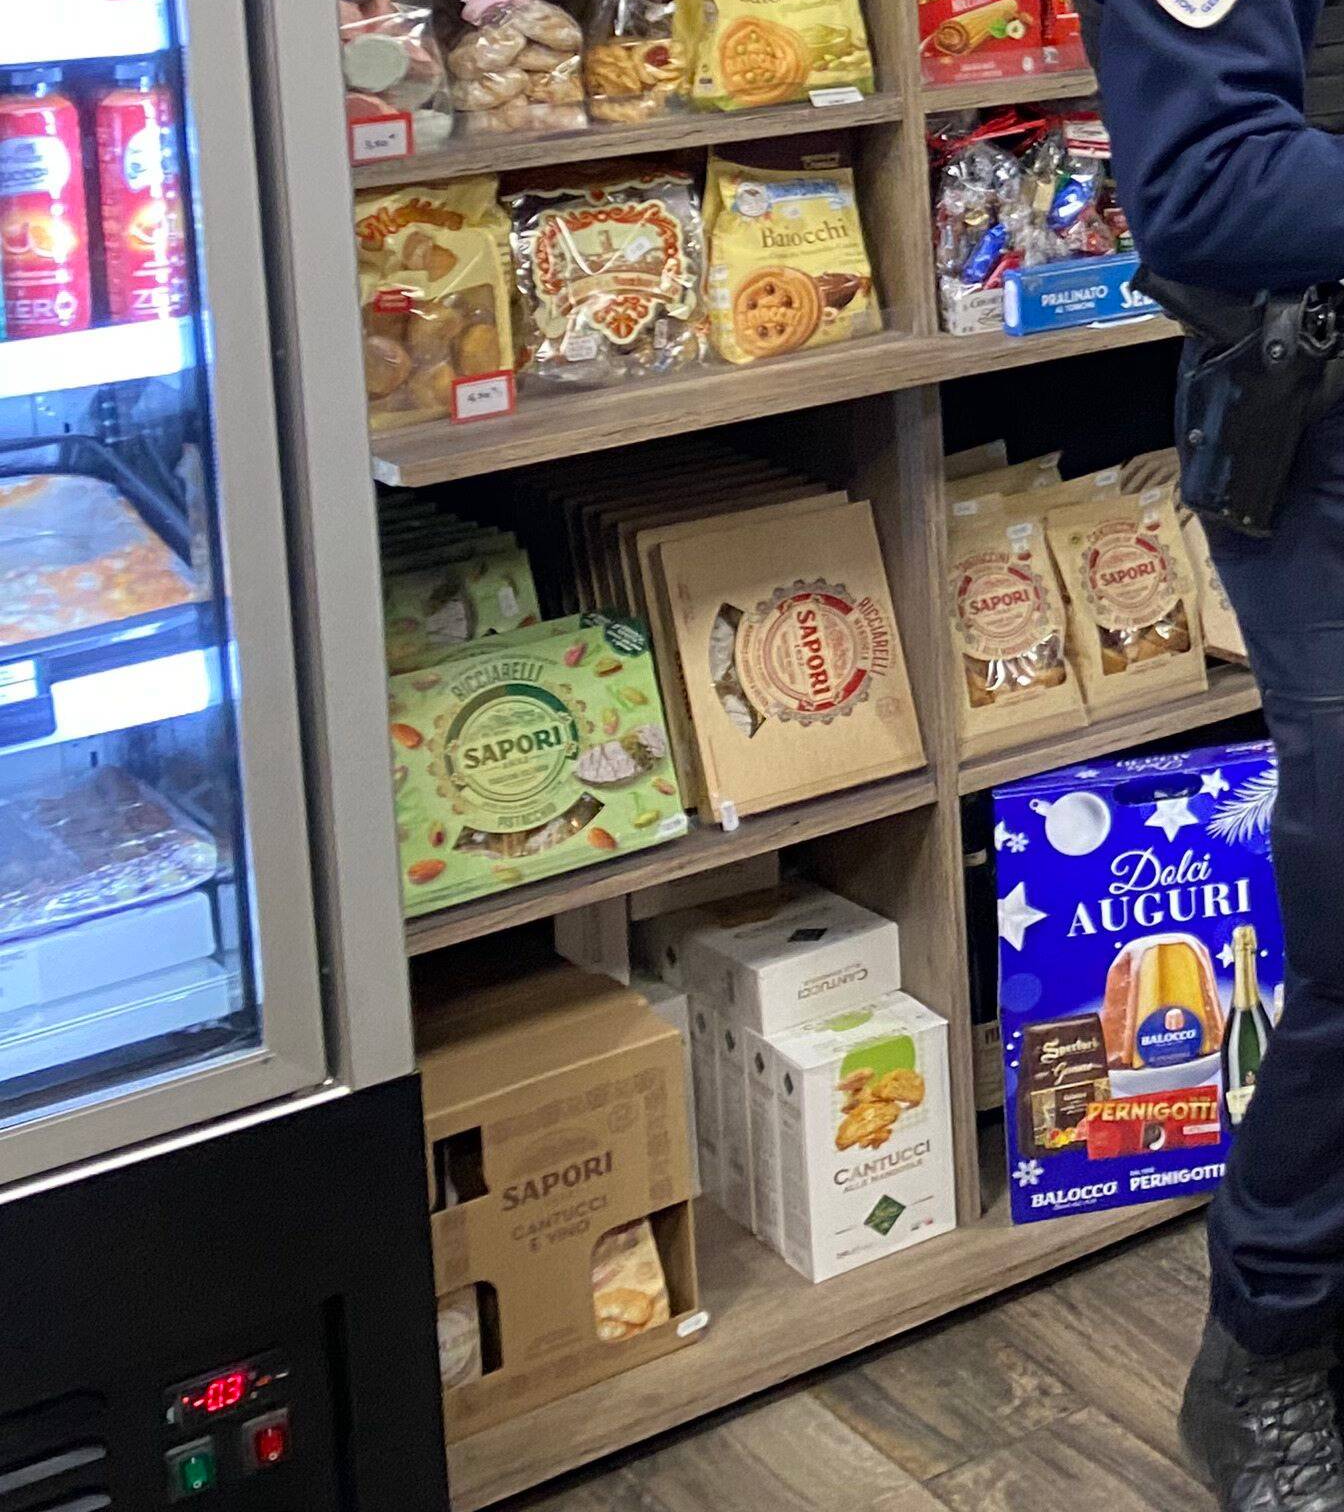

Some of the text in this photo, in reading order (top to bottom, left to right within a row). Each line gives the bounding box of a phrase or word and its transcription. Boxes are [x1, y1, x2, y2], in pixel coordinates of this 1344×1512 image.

[761, 217, 849, 249] Baiocchi
[1041, 285, 1108, 307] PRALINATO
[1101, 560, 1157, 587] SAPORI
[969, 589, 1030, 615] SAPORI
[796, 608, 831, 696] SAPORI
[857, 595, 890, 678] RICCIARELLI
[451, 661, 545, 702] RICCIARELLI
[463, 725, 563, 770] SAPORI
[1110, 846, 1212, 895] Dolci
[1066, 878, 1252, 938] AUGURI
[1141, 1028, 1198, 1046] BALOCCO
[1086, 1100, 1217, 1123] PERNIGOTTI
[833, 1138, 931, 1186] CANTUCCI
[1129, 1162, 1227, 1192] PERNIGOTTI
[502, 1150, 613, 1212] SAPORI
[1030, 1181, 1119, 1208] BALOCCO
